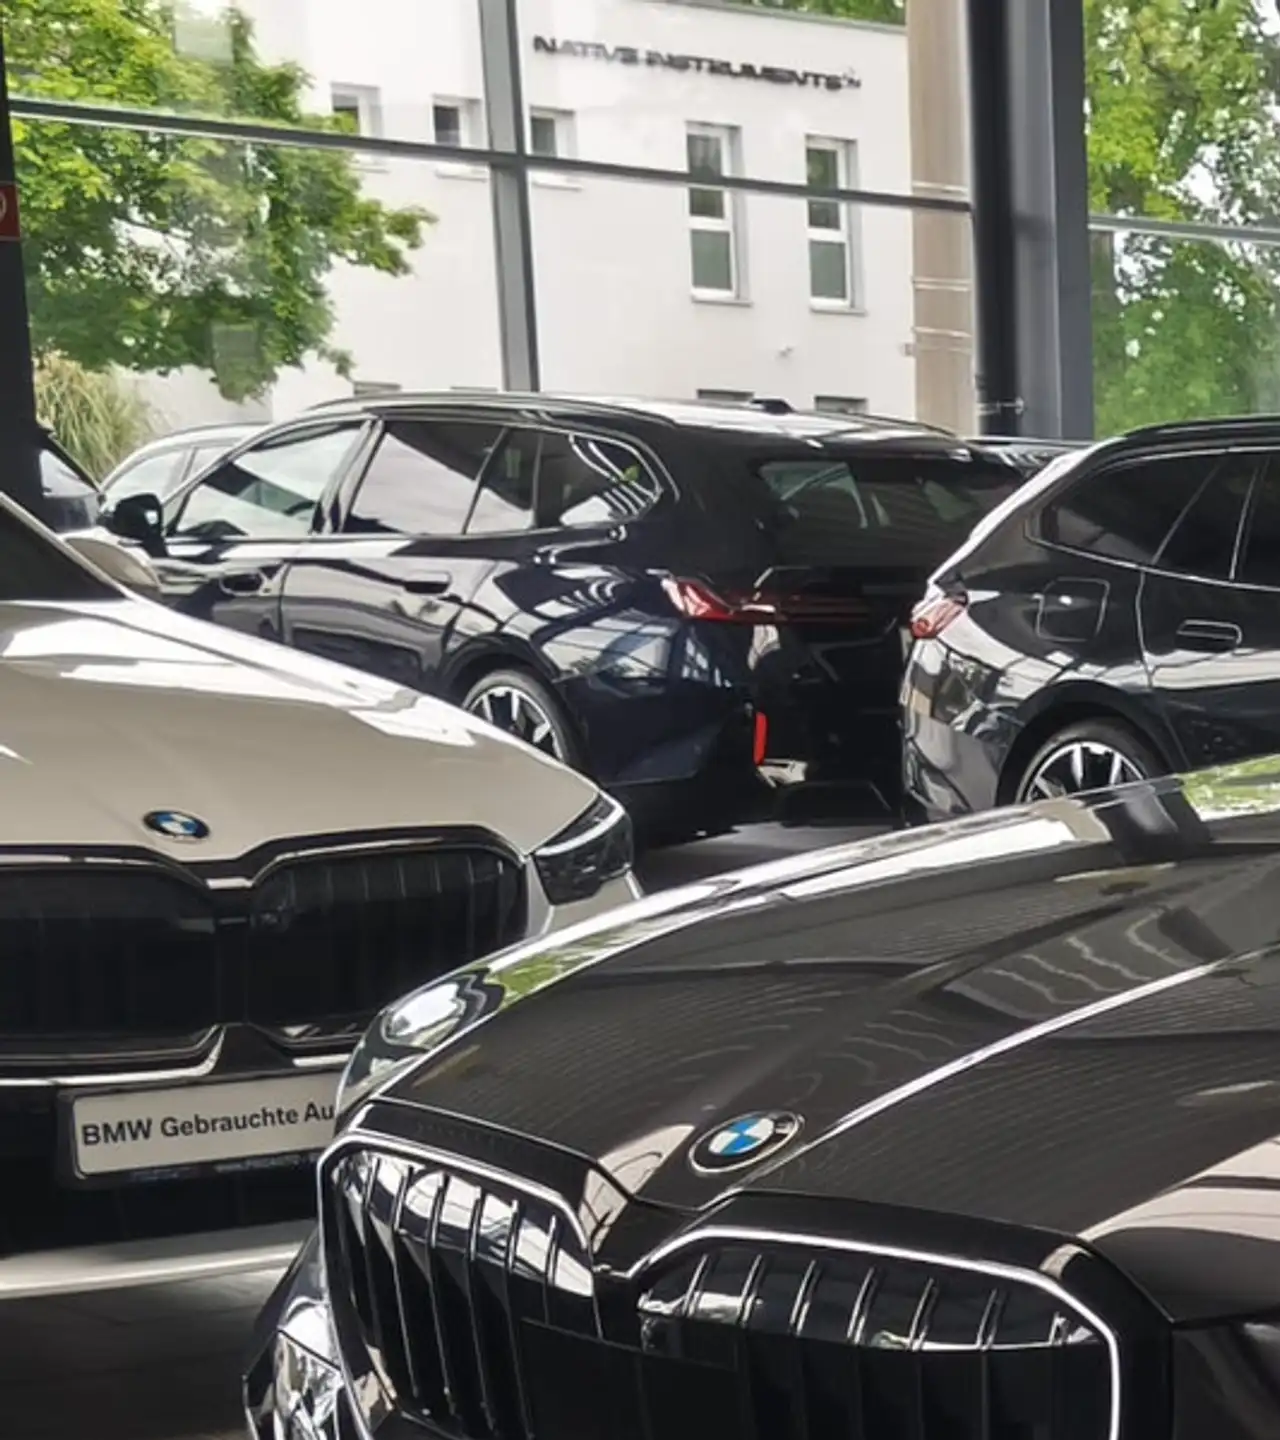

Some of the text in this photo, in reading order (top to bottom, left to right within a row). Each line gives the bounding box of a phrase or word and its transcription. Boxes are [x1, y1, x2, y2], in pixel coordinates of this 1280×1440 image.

[532, 35, 638, 65] NATIVE
[82, 1118, 153, 1147] BMW
[160, 1107, 299, 1138] Gebrauchte
